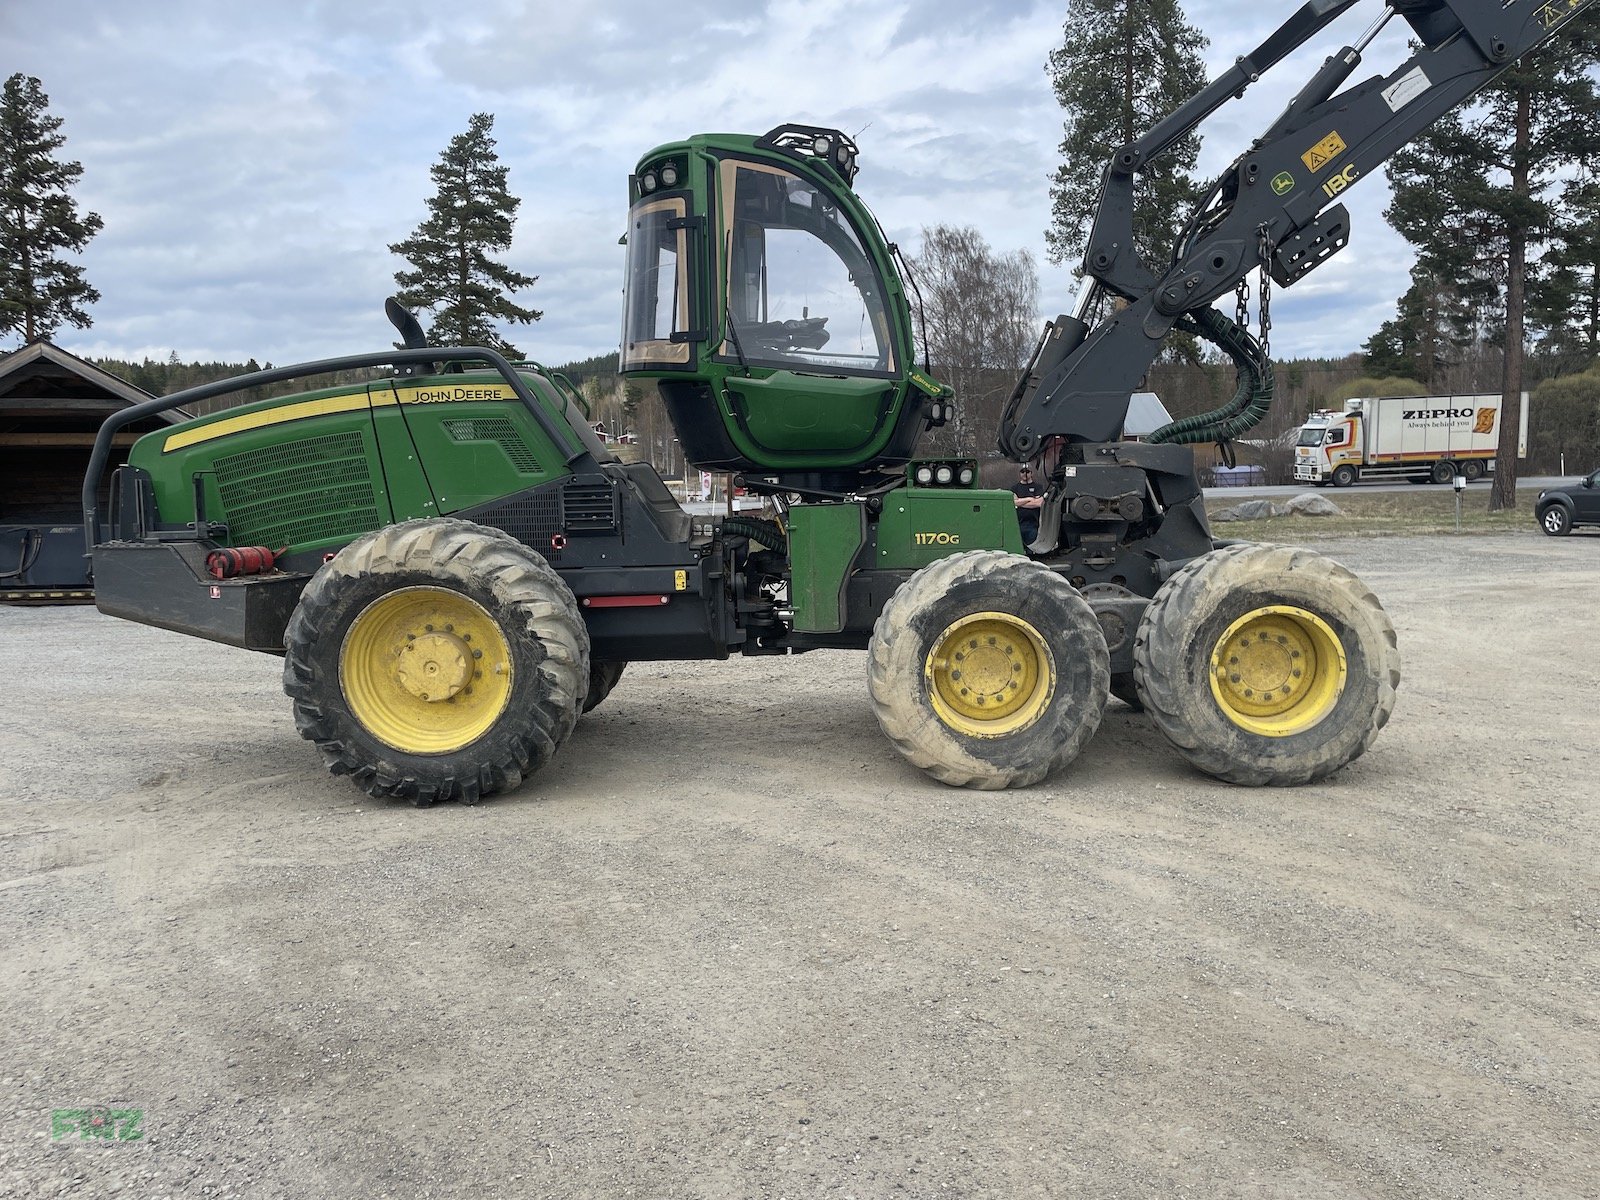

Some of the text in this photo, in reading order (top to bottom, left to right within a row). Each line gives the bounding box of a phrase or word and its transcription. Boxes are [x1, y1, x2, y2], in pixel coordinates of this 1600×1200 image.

[412, 388, 502, 403] JOHN DEERE
[1402, 408, 1474, 420] ZEPRO
[1432, 420, 1455, 428] behind
[914, 532, 960, 545] 1170G
